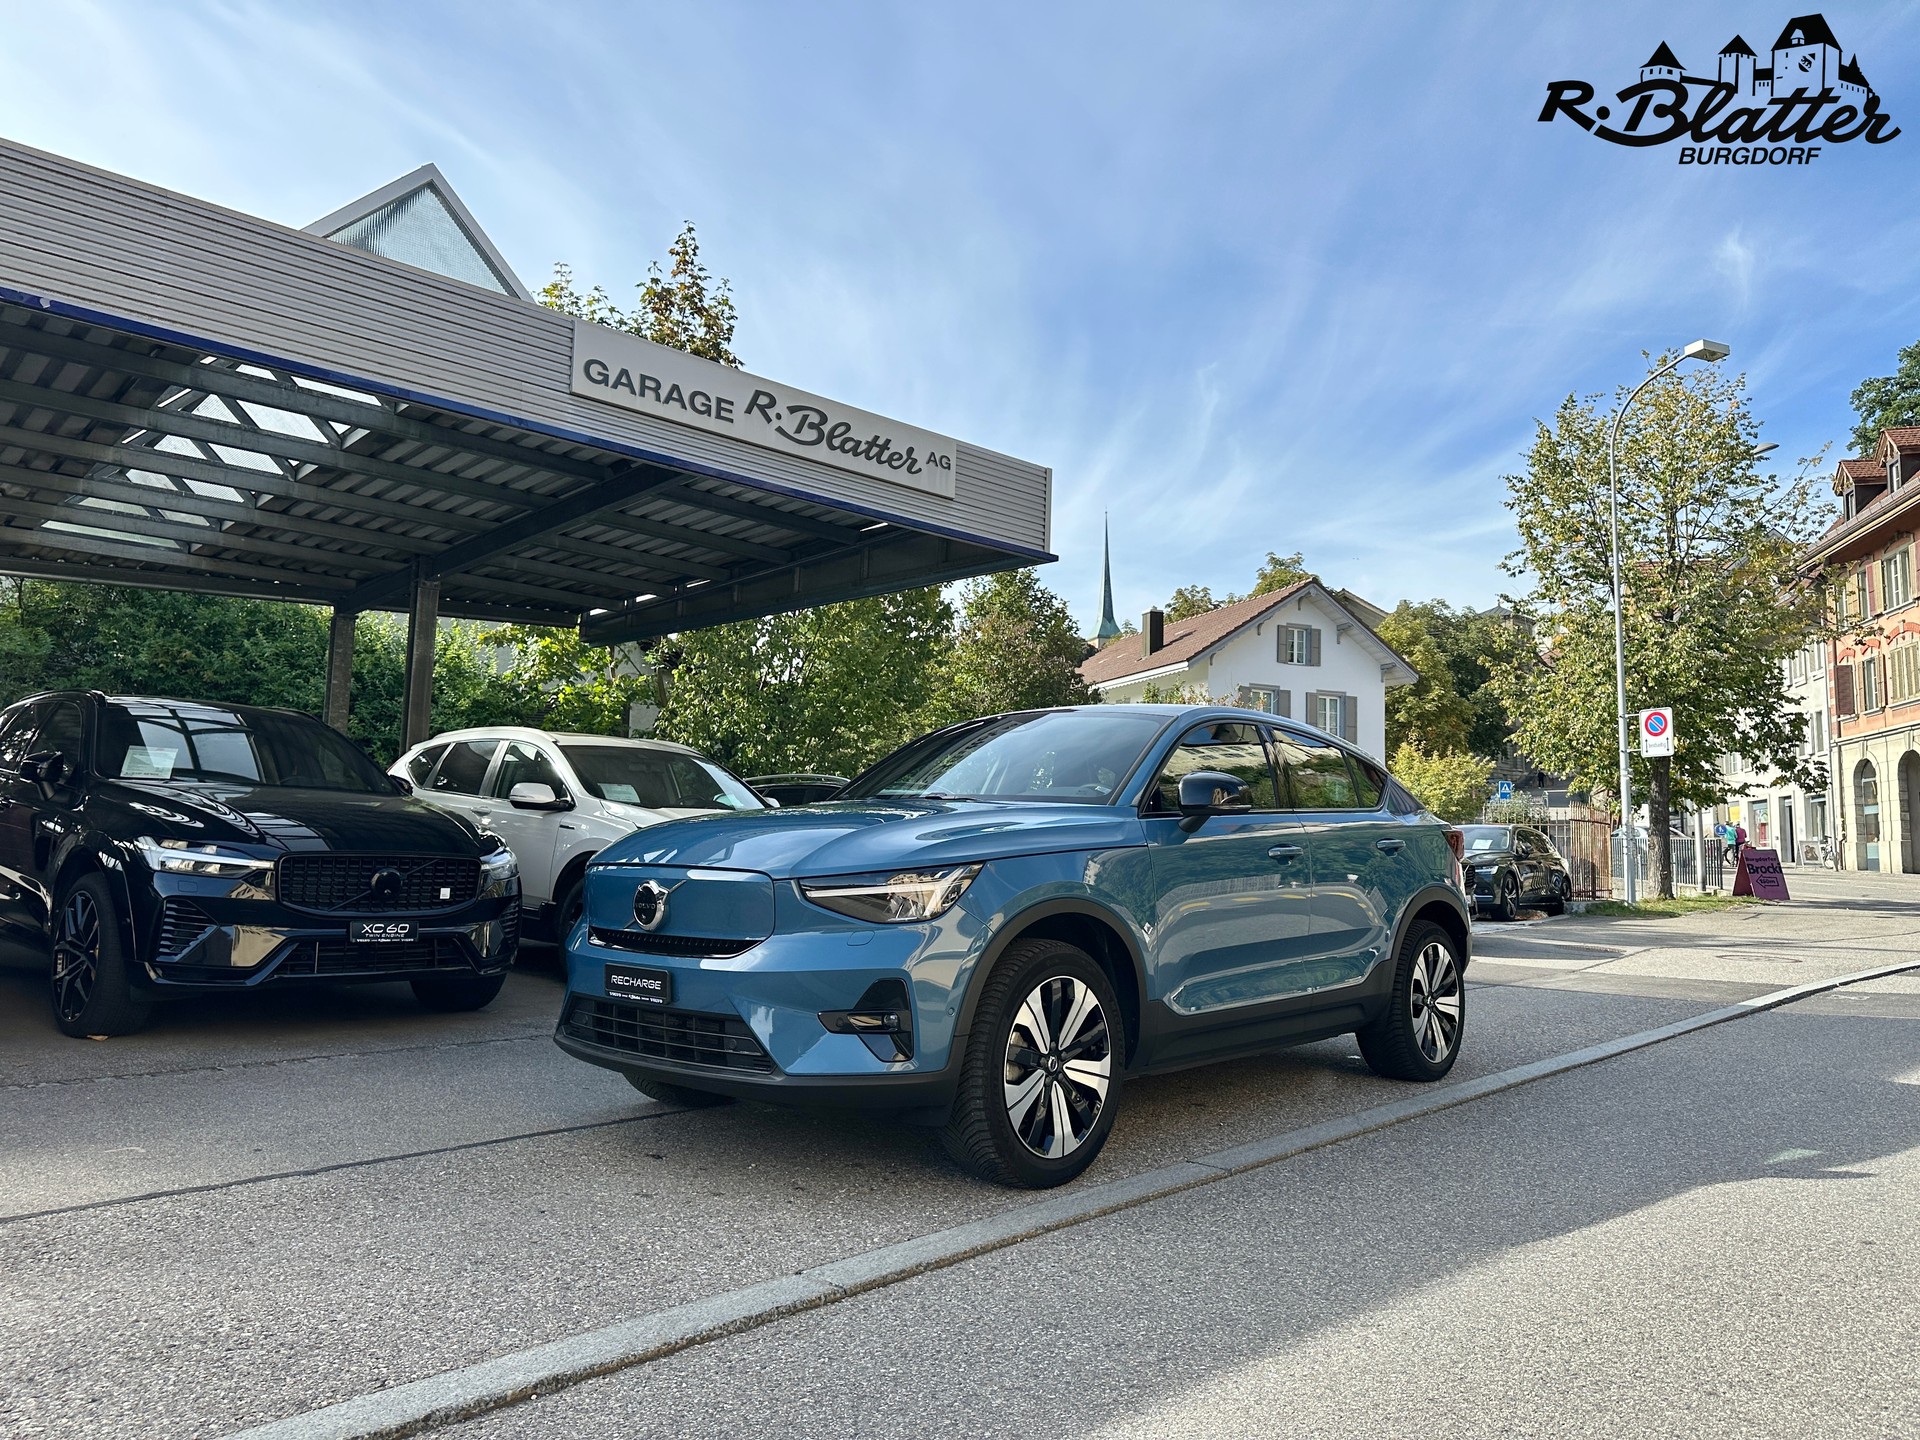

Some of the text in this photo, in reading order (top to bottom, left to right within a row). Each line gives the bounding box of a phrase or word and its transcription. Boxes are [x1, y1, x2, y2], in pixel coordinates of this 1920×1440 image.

[583, 358, 735, 424] GARAGE
[925, 451, 951, 471] AG
[1747, 863, 1782, 874] Brocki
[635, 902, 656, 910] VOLVO
[611, 975, 662, 990] RECHARGE
